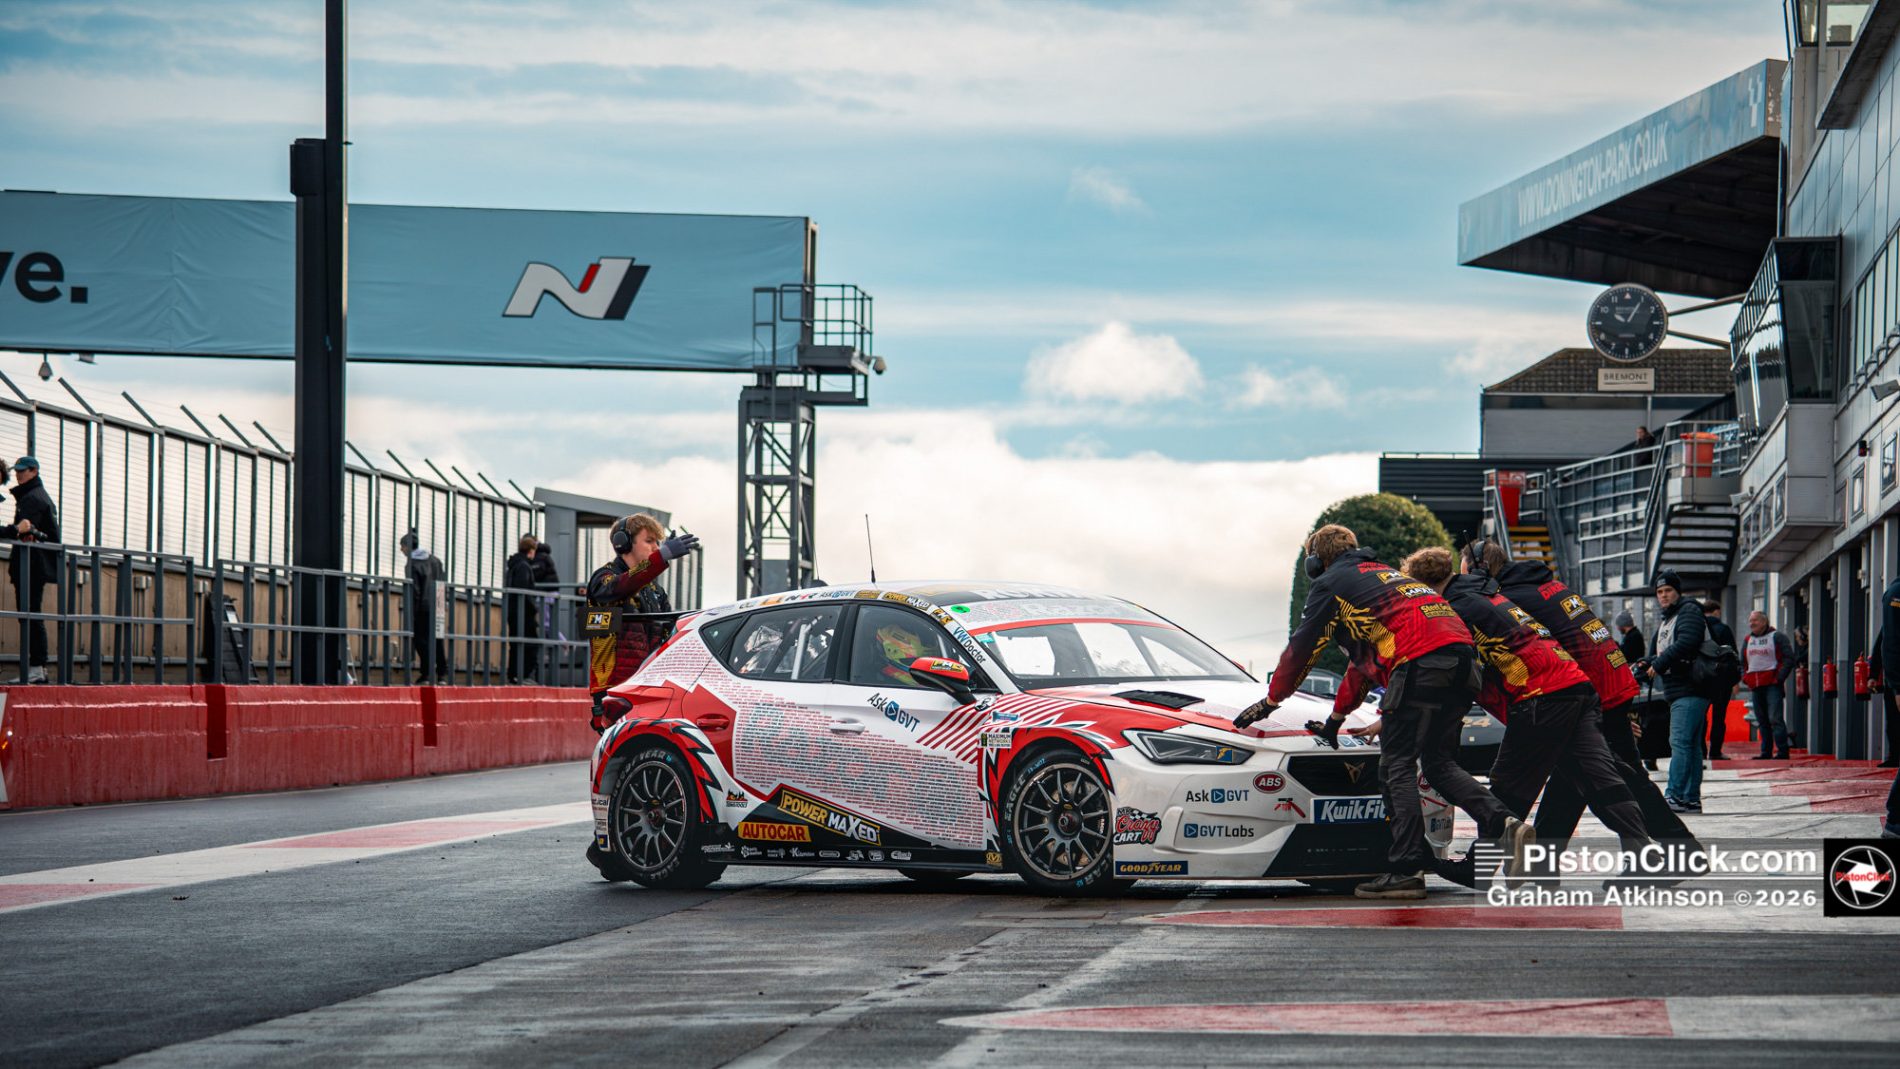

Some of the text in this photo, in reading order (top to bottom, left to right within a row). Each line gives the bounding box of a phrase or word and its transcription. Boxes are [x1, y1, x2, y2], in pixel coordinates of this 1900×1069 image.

[1517, 121, 1669, 227] WWW.DONINGTON-PARK.CO.UK
[867, 692, 920, 732] Ask GVT
[1258, 777, 1281, 787] ABS
[1004, 774, 1026, 821] EAGLE
[1186, 789, 1250, 802] Ask GVT
[782, 794, 877, 841] POWER MAXED
[742, 824, 806, 841] AUTOCAR
[1113, 831, 1142, 843] CART
[1200, 824, 1254, 838] GVTLabs
[1120, 862, 1182, 874] GOODYEAR
